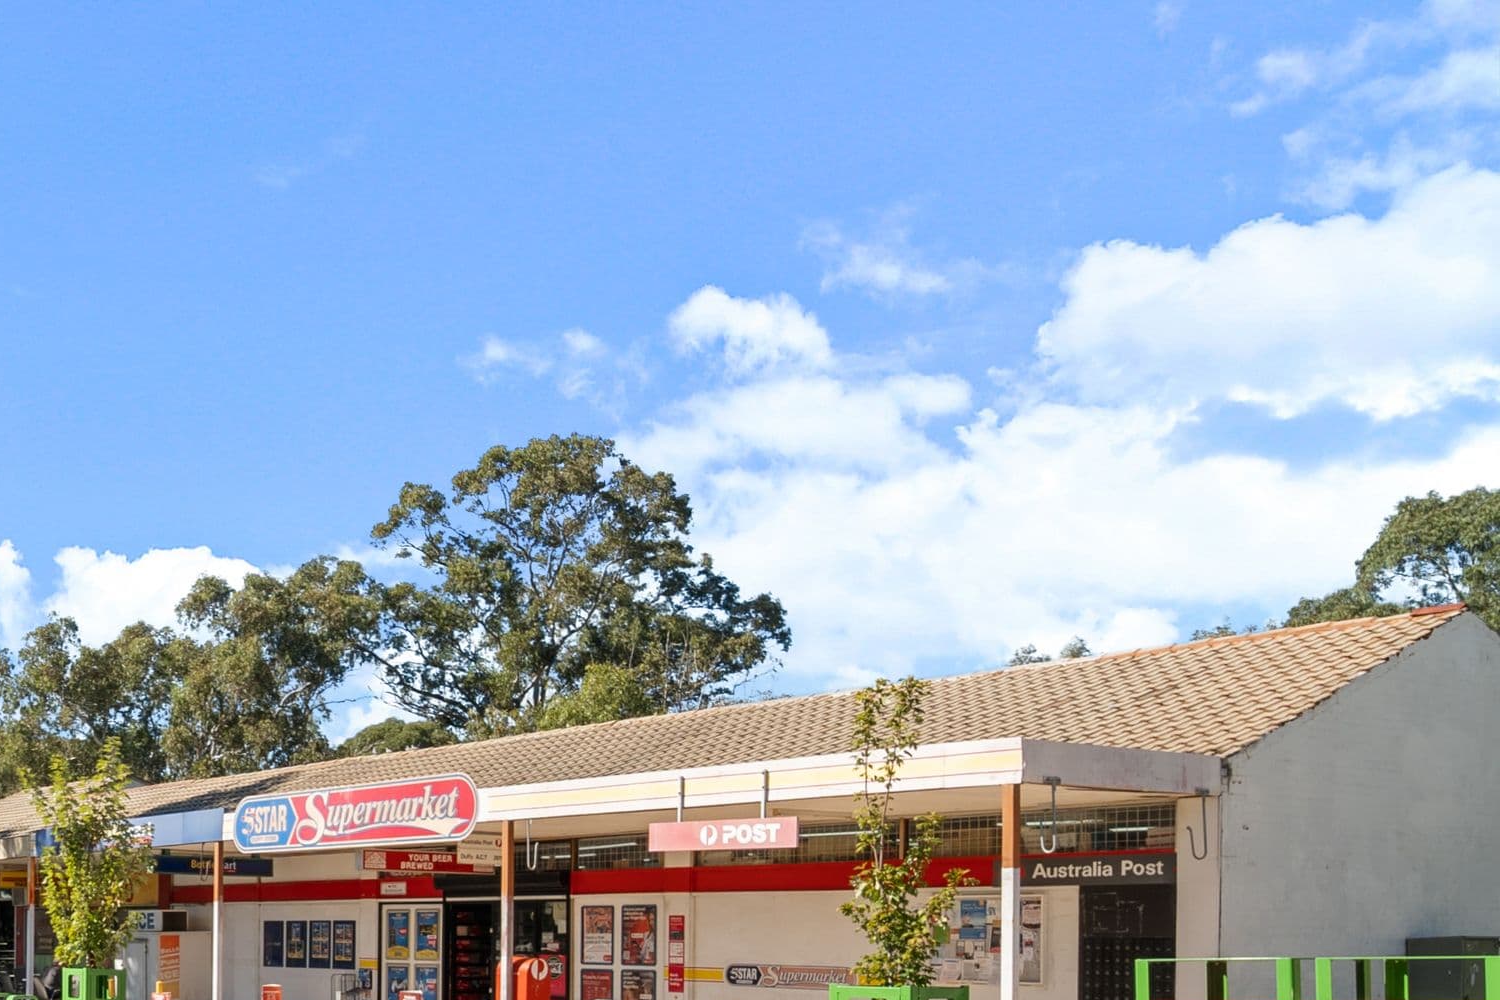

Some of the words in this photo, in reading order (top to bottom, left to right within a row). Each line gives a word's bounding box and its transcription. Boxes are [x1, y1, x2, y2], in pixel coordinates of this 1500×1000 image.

[296, 785, 460, 845] Supermarket
[722, 823, 781, 844] POST
[400, 862, 434, 870] BREWED
[408, 853, 431, 862] YOUR
[432, 854, 453, 863] BEER
[1032, 861, 1113, 879] Australia
[1121, 860, 1164, 876] Post
[761, 966, 847, 987] Supermarket
